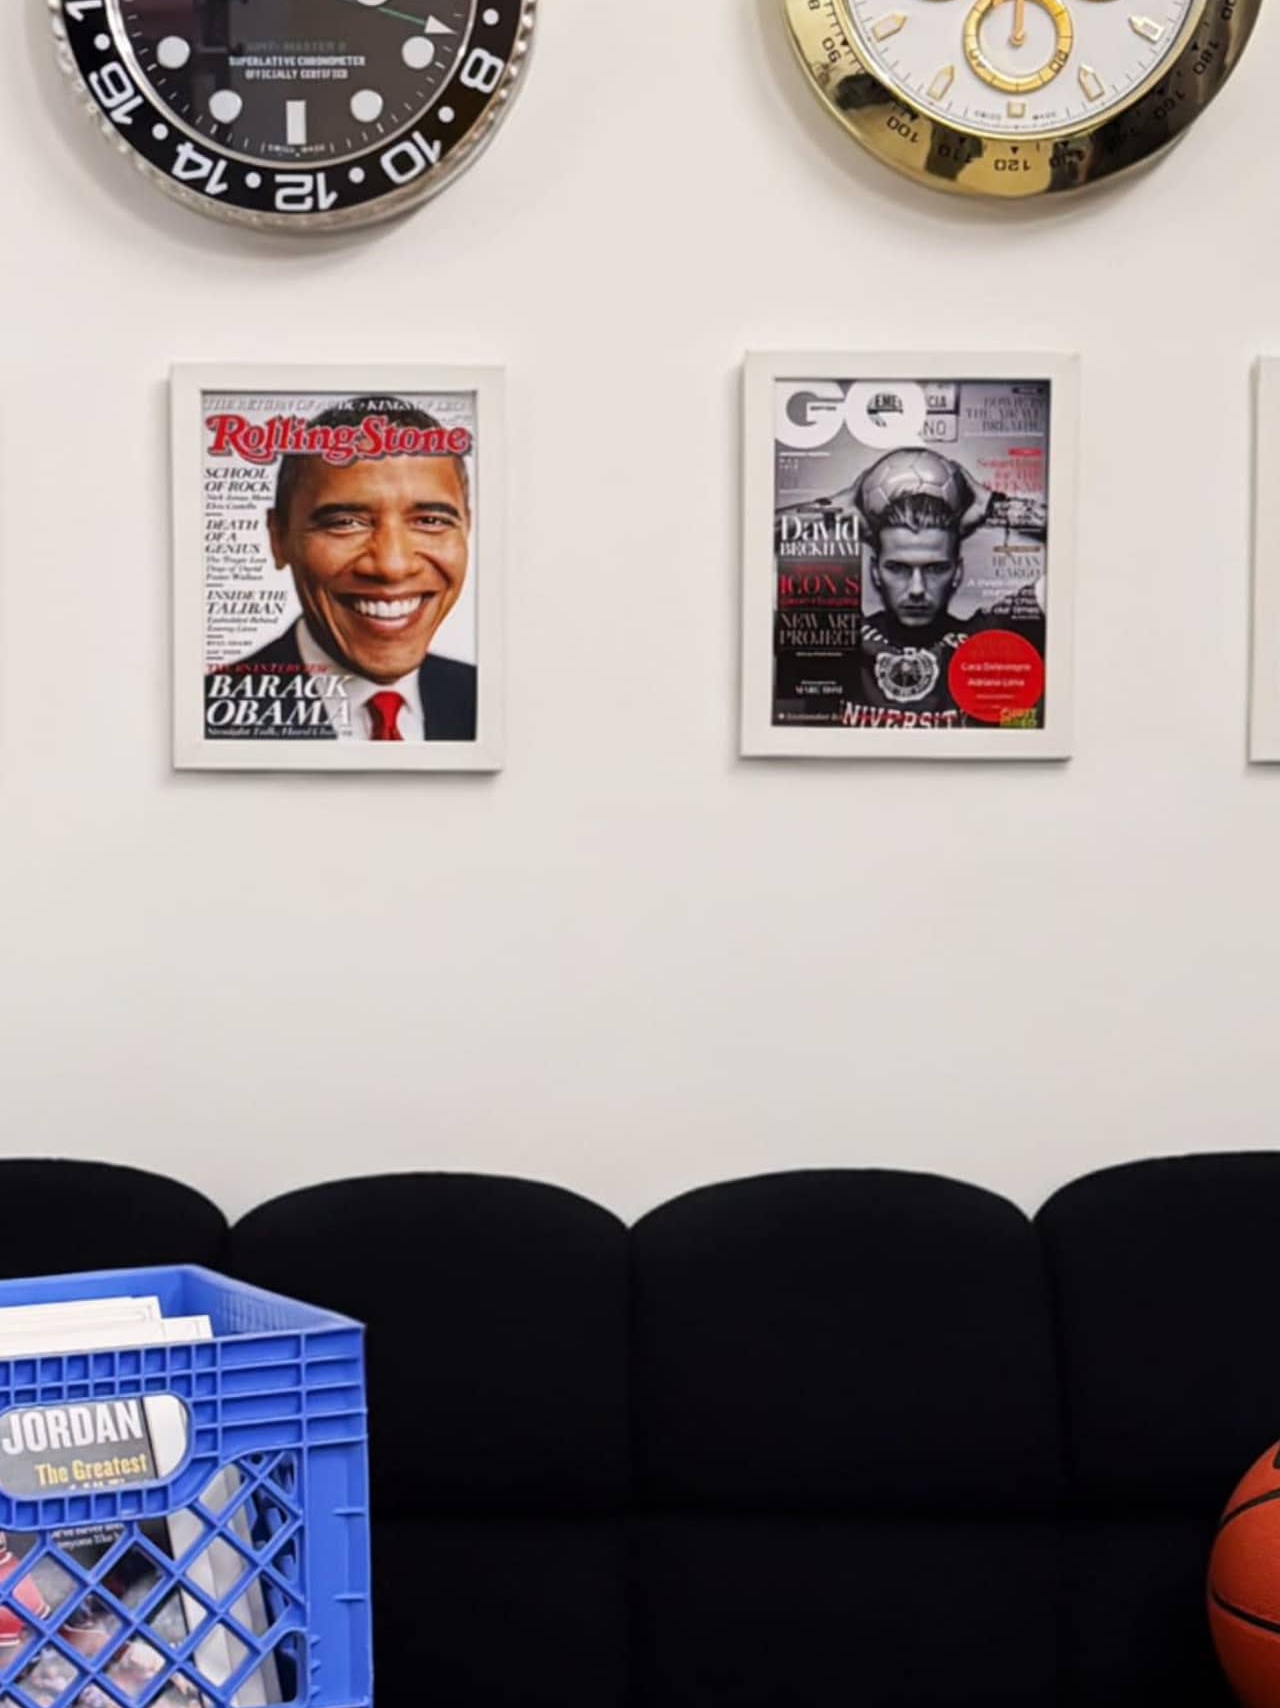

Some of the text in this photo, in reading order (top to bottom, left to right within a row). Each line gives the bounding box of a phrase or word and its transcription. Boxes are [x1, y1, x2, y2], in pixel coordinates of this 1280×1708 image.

[775, 381, 927, 449] GQ
[206, 414, 472, 467] Rolling Stone
[204, 468, 269, 479] SCHOOL
[205, 481, 272, 492] OF ROCK
[206, 520, 259, 530] DEATH
[781, 516, 859, 541] David
[205, 532, 225, 542] OF
[205, 544, 260, 554] GENIUS
[780, 543, 860, 557] BECKHAM
[207, 590, 288, 600] INSIDE THE
[207, 602, 287, 614] TALIBAN
[781, 613, 860, 629] NEW ART
[779, 630, 859, 646] PROJECT
[208, 674, 352, 698] BARACK
[206, 700, 351, 726] OBAMA
[1, 1400, 144, 1455] JORDAN
[35, 1454, 147, 1486] The Greatest
